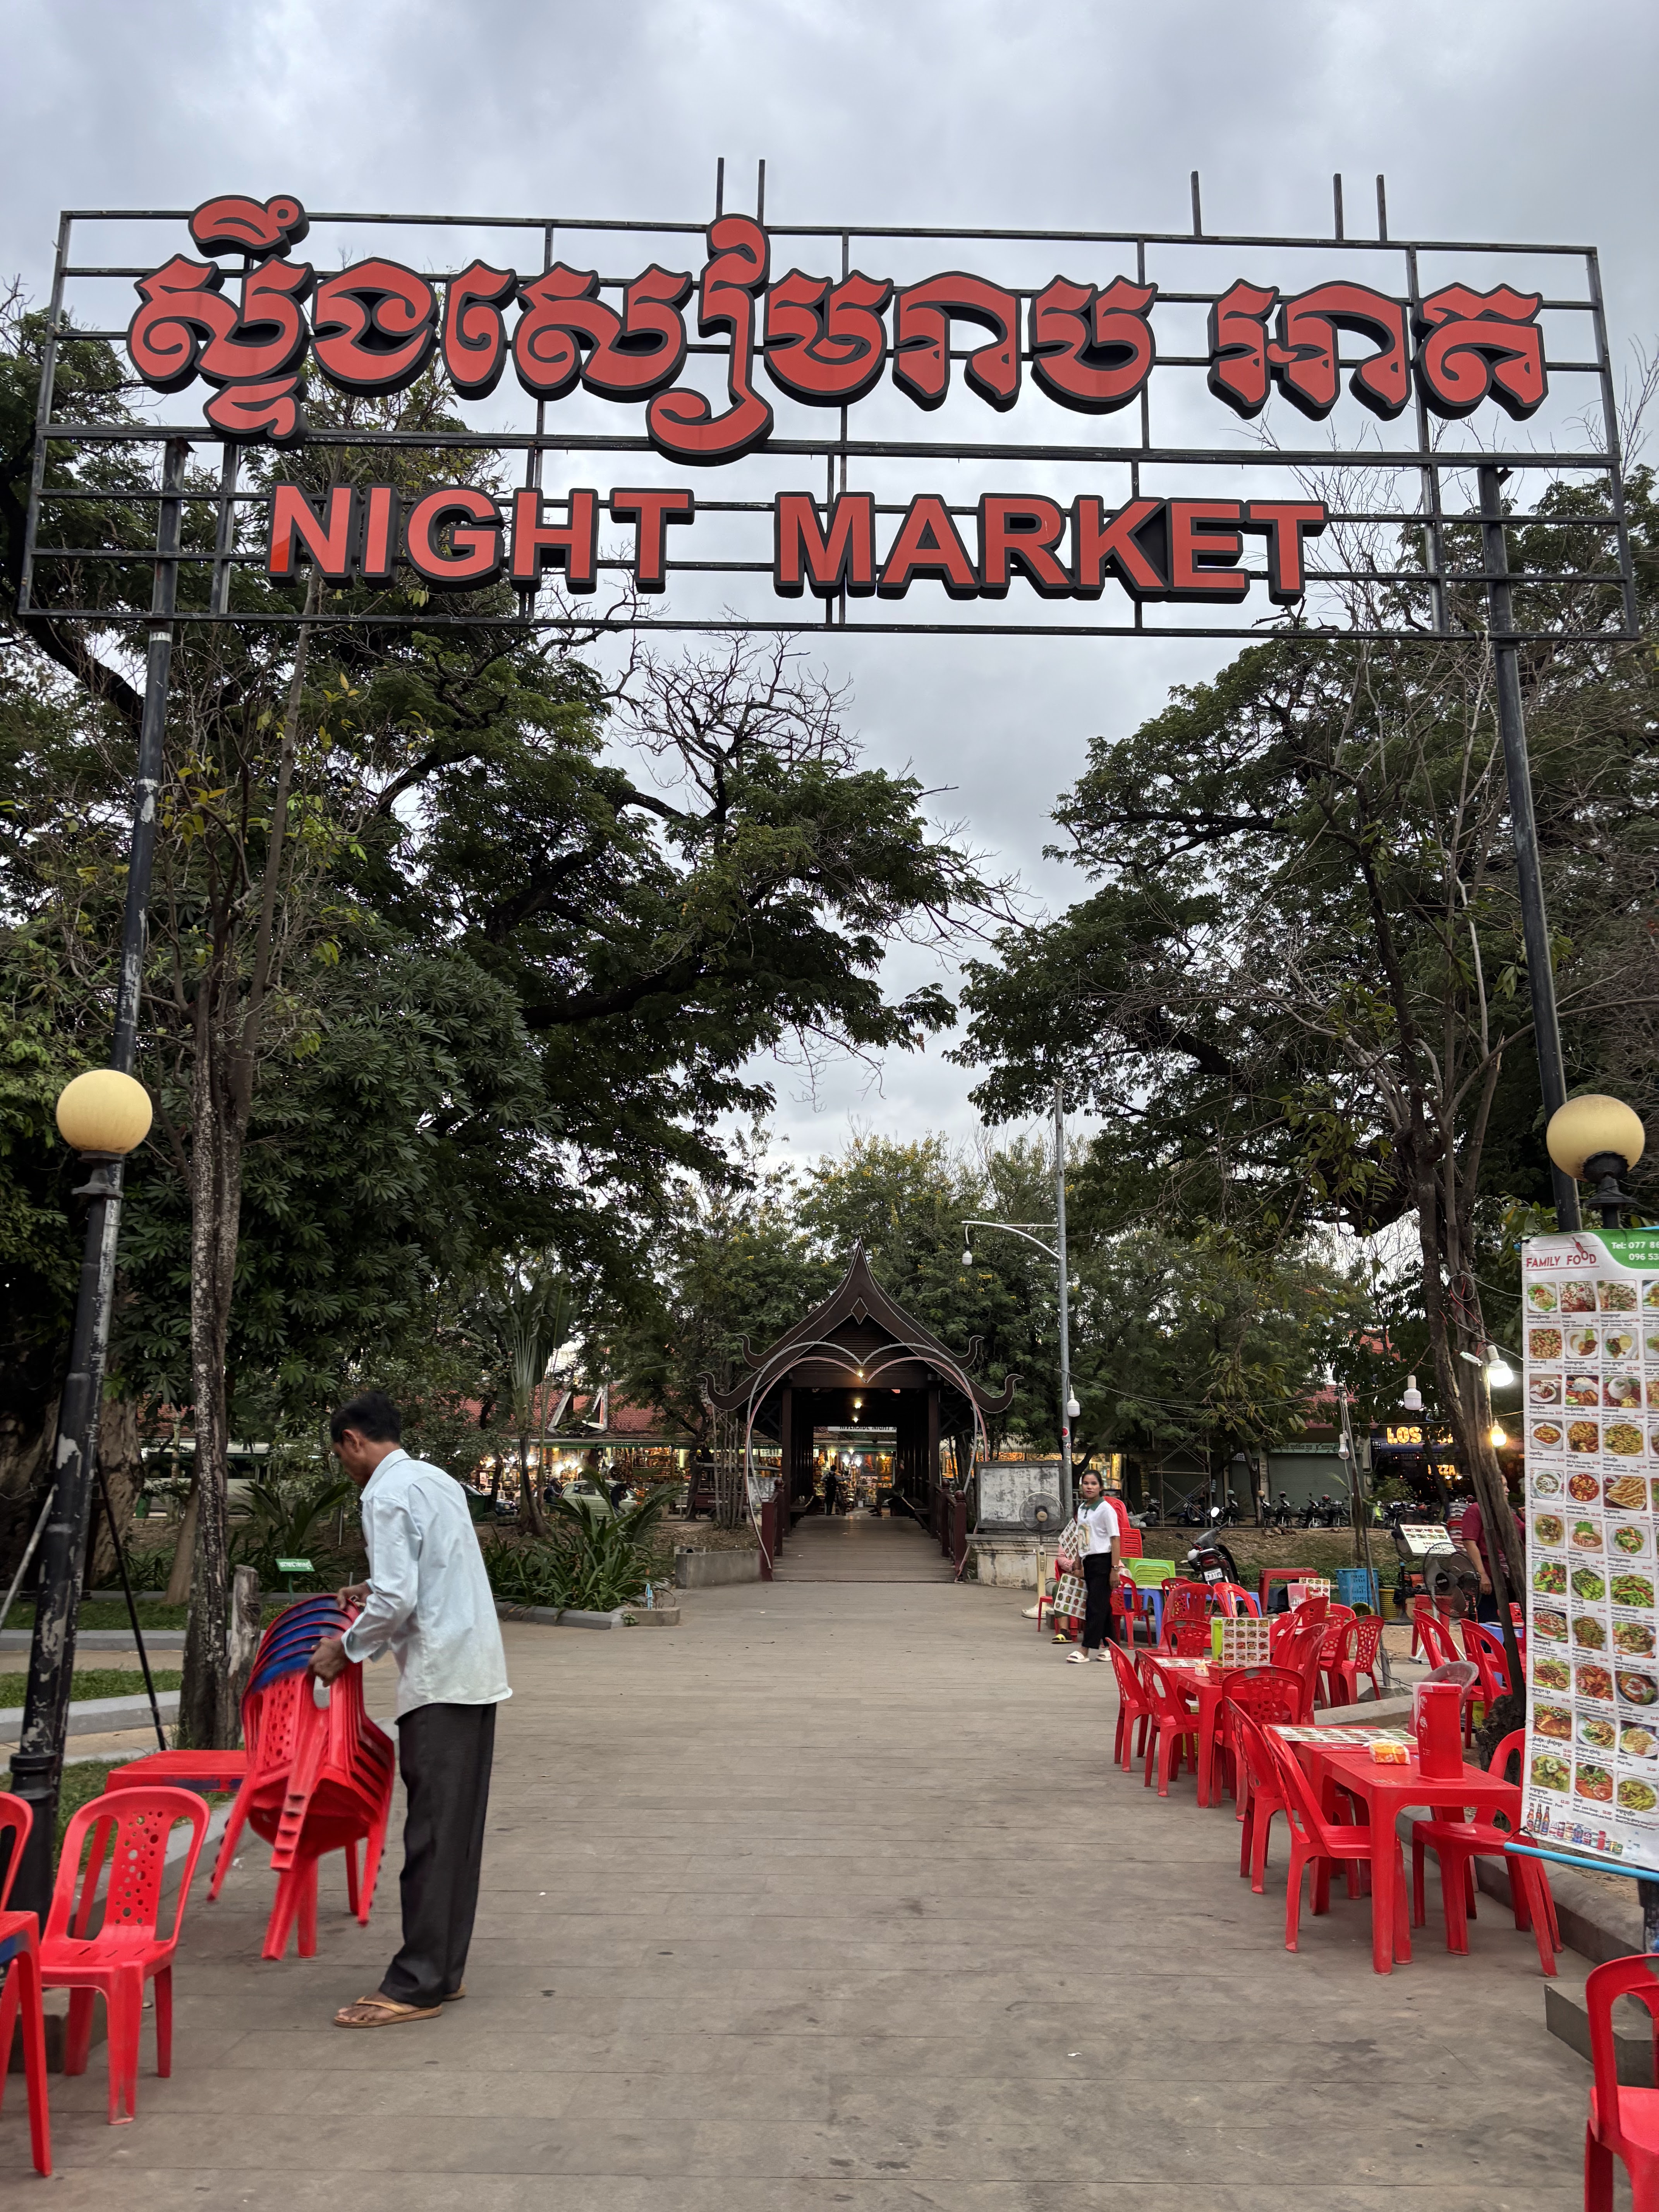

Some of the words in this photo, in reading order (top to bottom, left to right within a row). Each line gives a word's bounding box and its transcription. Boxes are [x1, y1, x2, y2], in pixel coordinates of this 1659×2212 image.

[265, 481, 694, 595] NIGHT
[774, 489, 1328, 606] MARKET
[1526, 1256, 1560, 1267] FAMILY
[1566, 1250, 1596, 1265] FOOD
